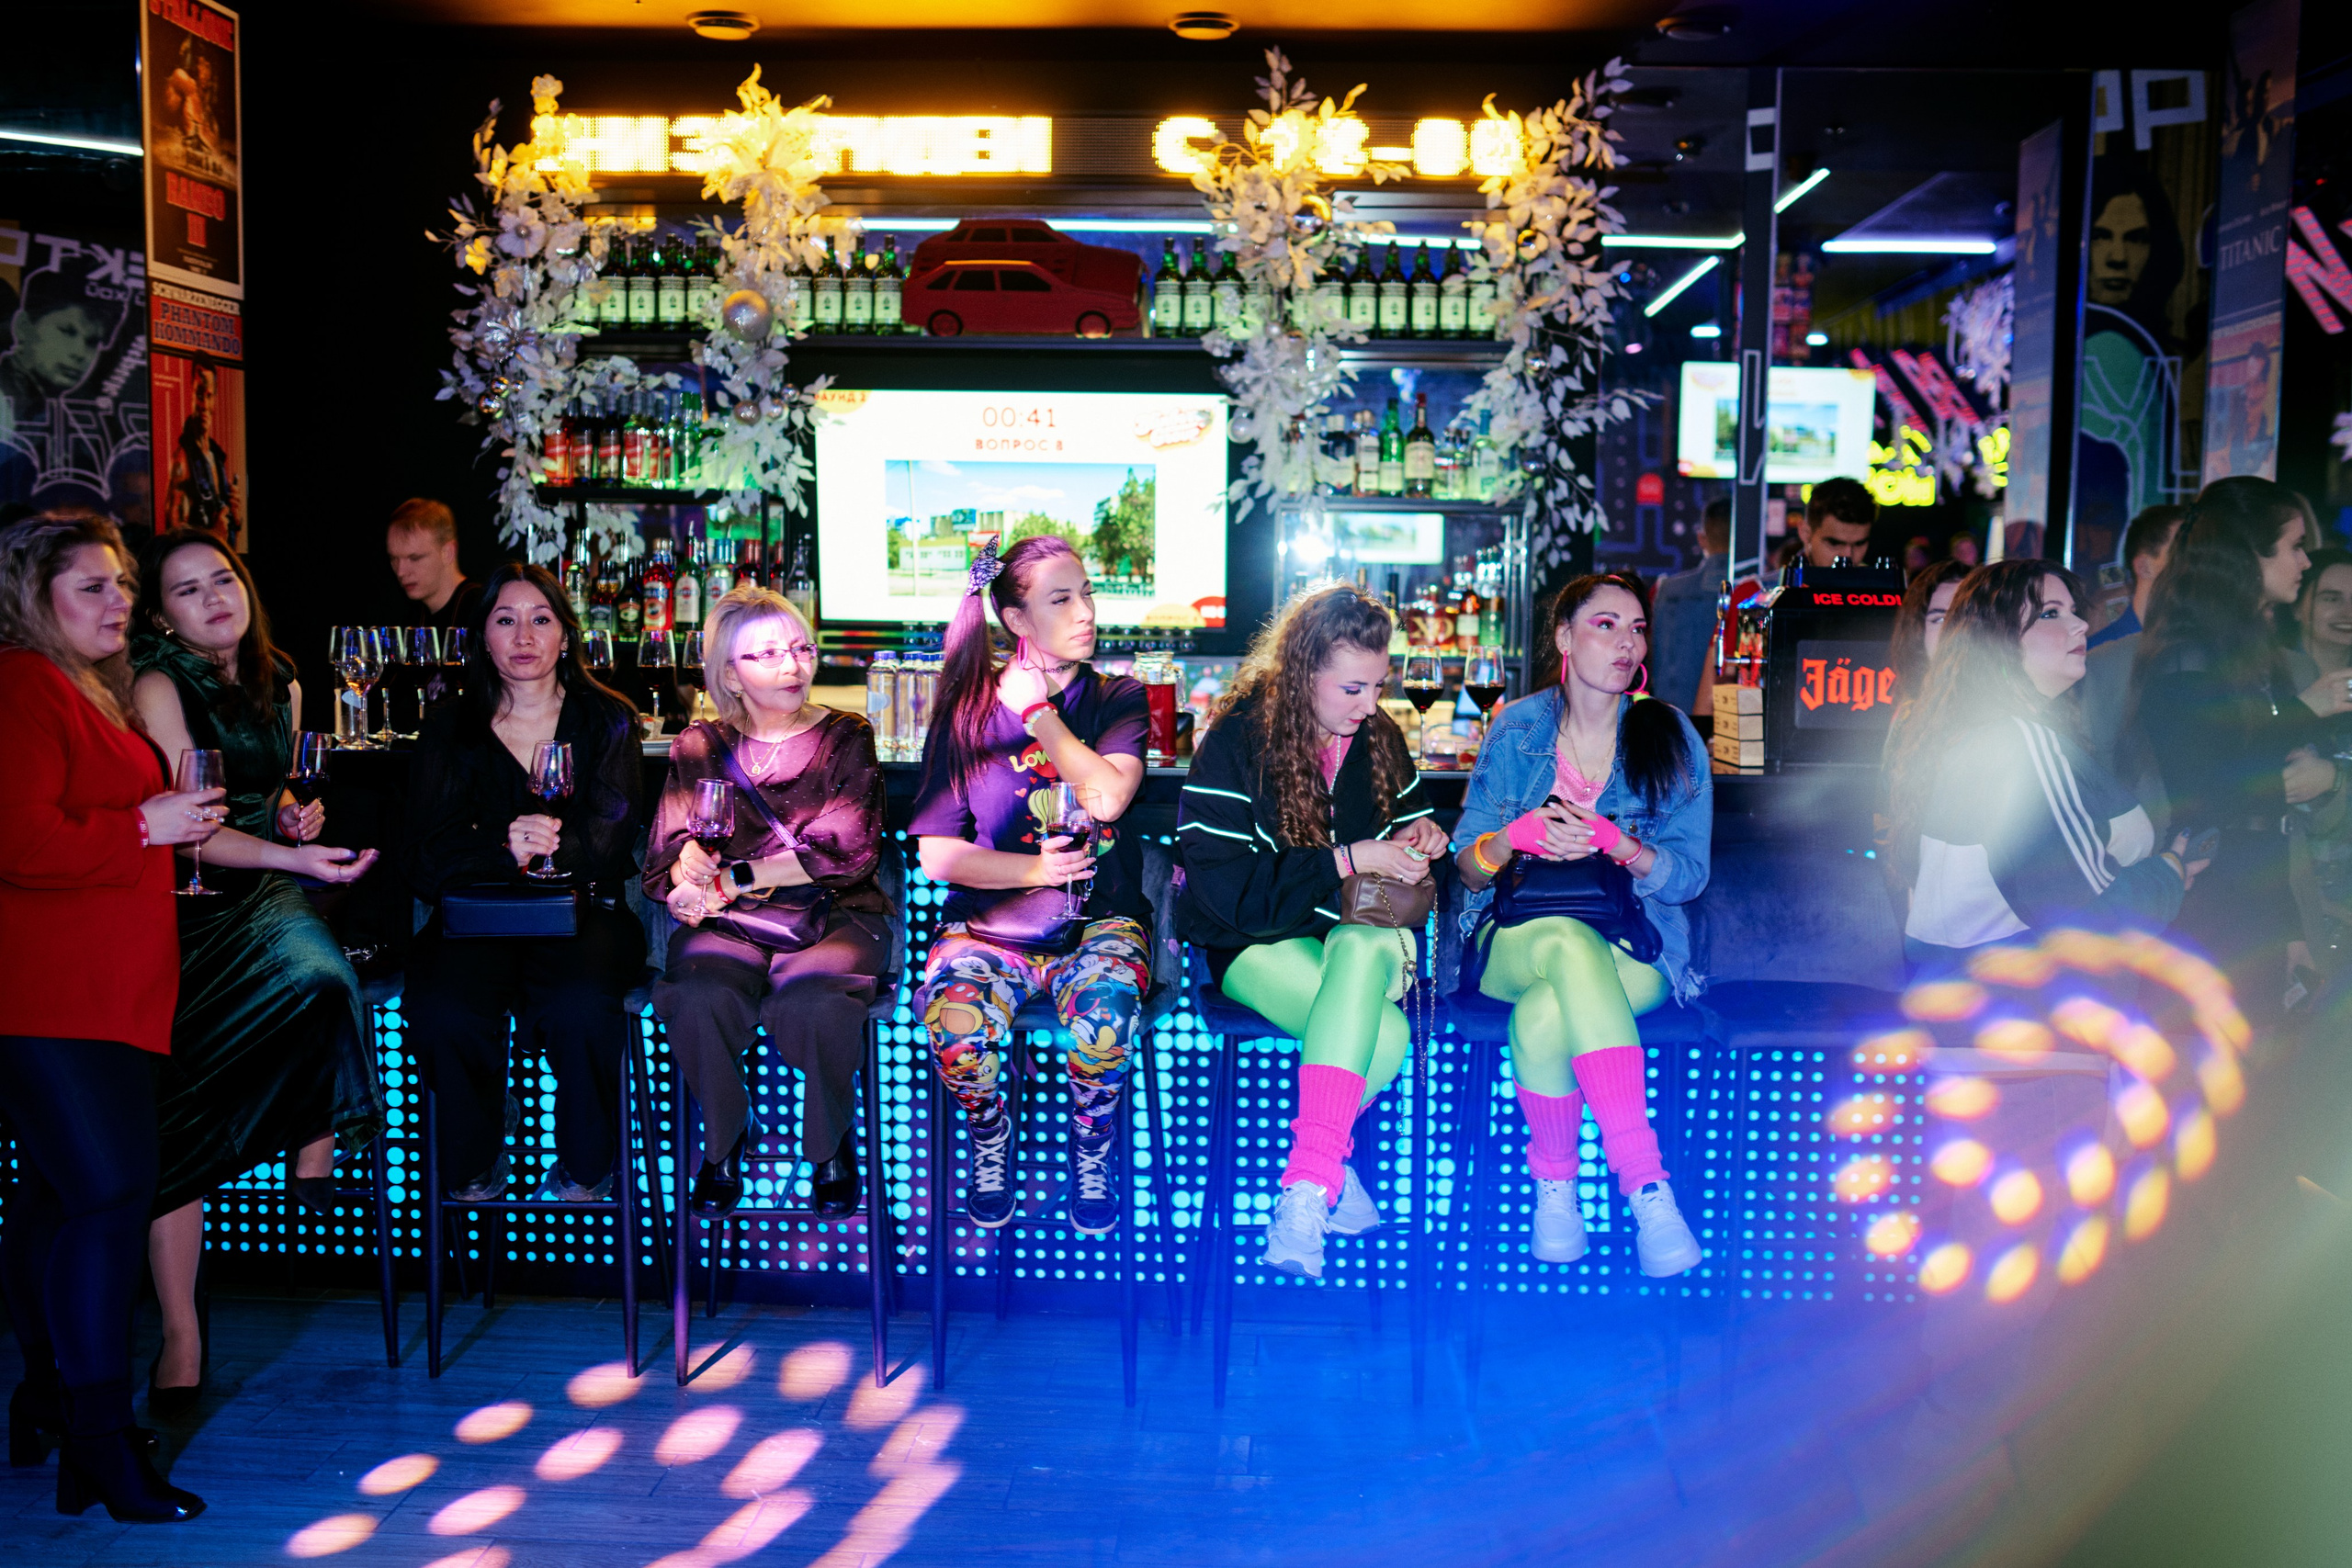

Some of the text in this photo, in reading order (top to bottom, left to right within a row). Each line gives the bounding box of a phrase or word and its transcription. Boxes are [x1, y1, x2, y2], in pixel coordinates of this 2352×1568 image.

[2220, 225, 2282, 272] TITANIC
[160, 302, 235, 335] PHANTOM
[154, 321, 241, 355] KOMMANDO
[983, 406, 1057, 428] 00:41
[976, 438, 1048, 451] ВОПРОС
[1813, 593, 1903, 606] ICE COLD!
